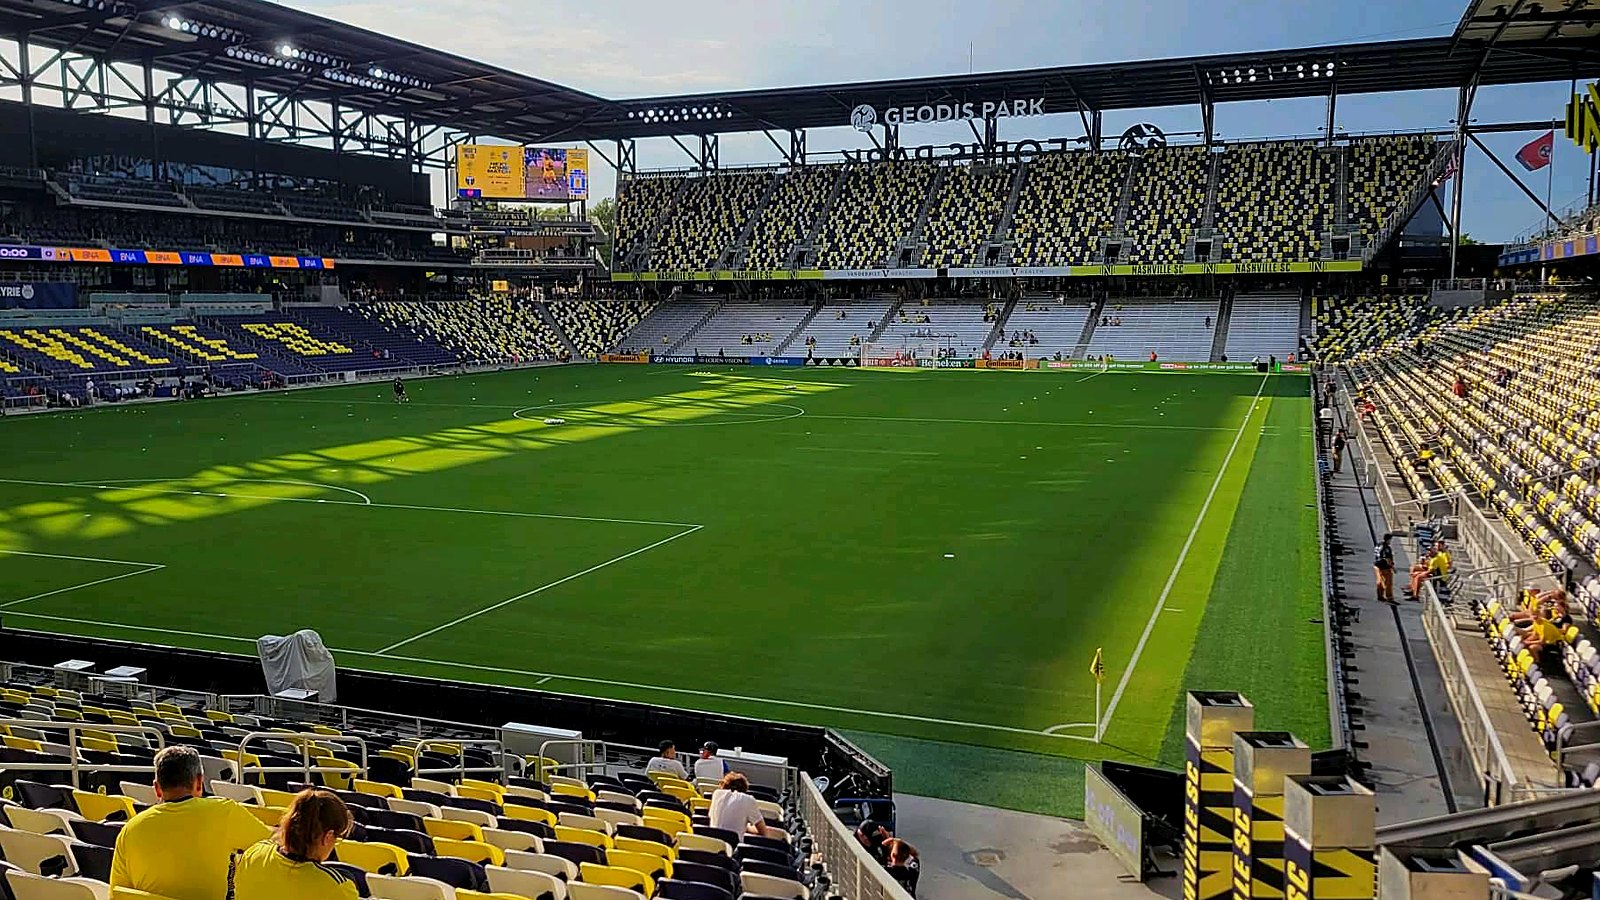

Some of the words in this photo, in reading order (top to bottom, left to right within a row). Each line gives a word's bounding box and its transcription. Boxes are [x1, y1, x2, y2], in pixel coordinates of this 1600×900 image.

[884, 103, 975, 126] GEODIS
[981, 97, 1045, 120] PARK
[120, 252, 137, 261] BNA
[189, 255, 204, 263] BNA
[249, 257, 264, 265] BNA
[304, 259, 317, 267] BNA
[1132, 264, 1170, 274] NASHVILLE
[1174, 264, 1184, 273] SC
[1235, 263, 1276, 273] NASHVILLE
[1280, 263, 1291, 272] SC
[657, 272, 686, 280] NASHVILLE
[687, 272, 695, 280] SC
[732, 271, 763, 279] NASHVILLE
[765, 271, 773, 279] SC
[0, 286, 21, 297] YRIE
[921, 359, 961, 367] Heneken
[1186, 760, 1199, 805] SC
[1234, 807, 1250, 856] SC
